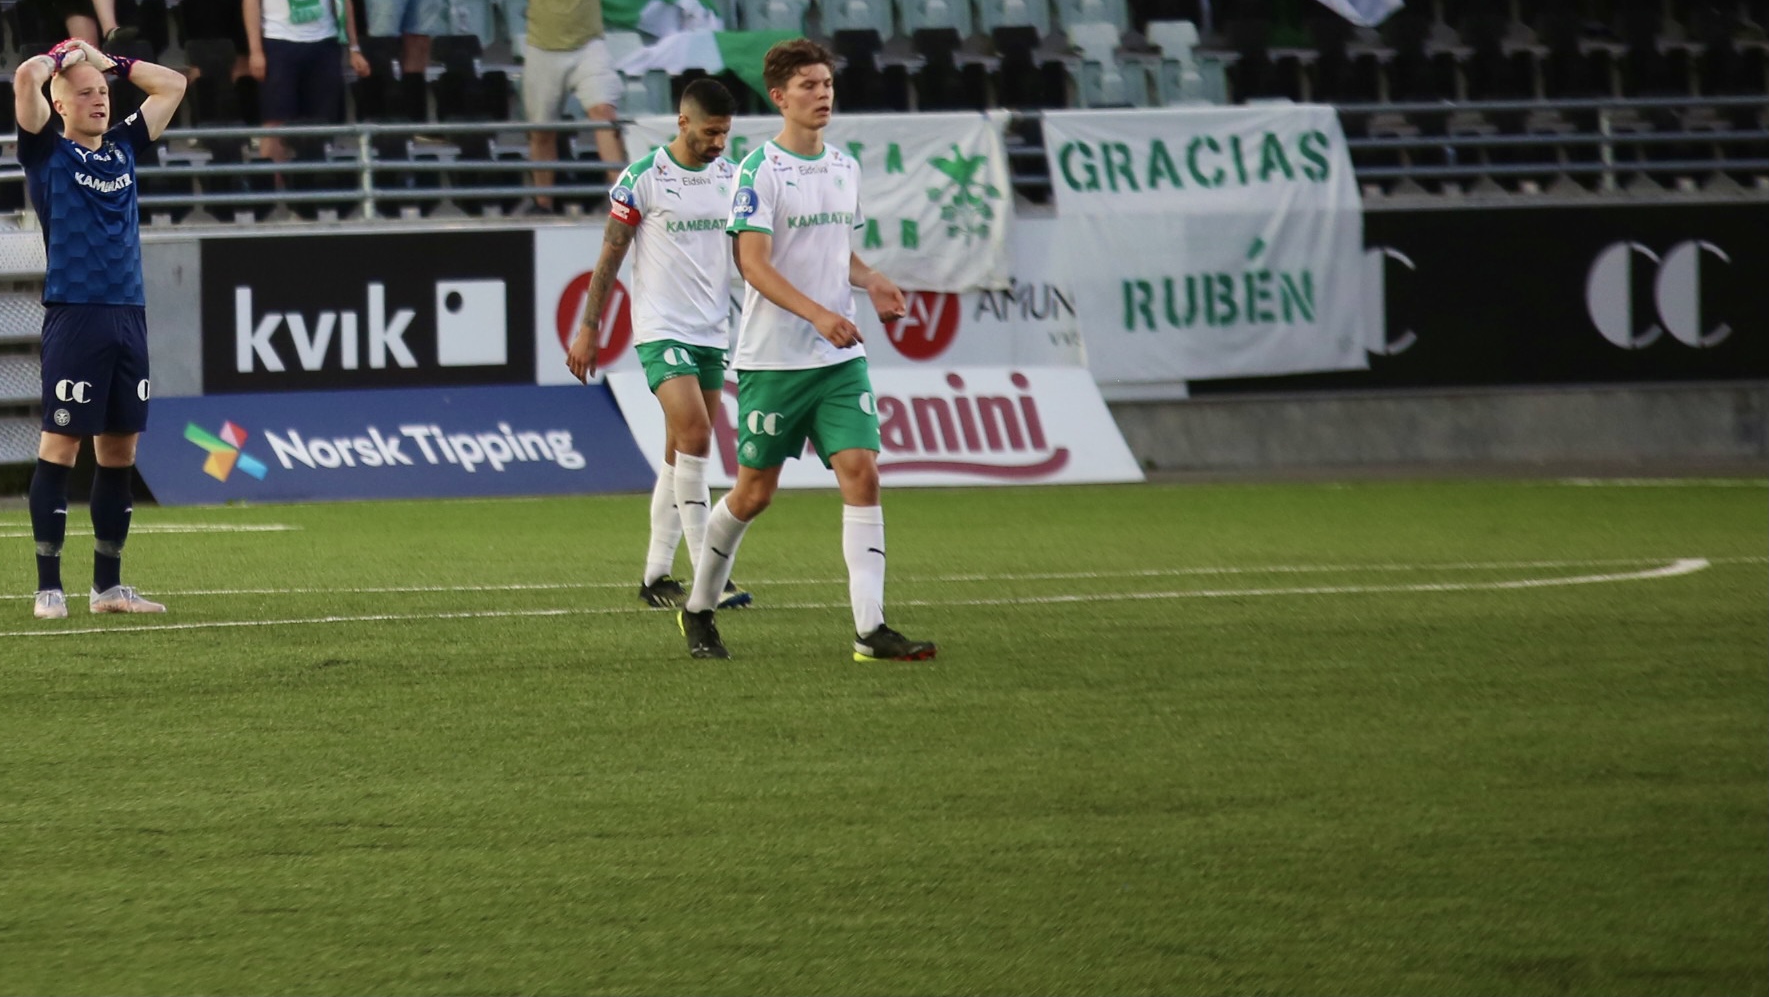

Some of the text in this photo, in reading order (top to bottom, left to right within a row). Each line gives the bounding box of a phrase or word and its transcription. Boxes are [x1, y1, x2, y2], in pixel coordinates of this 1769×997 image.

[1058, 130, 1330, 193] GRACIAS
[1122, 236, 1316, 332] RUBÉN
[1586, 240, 1733, 350] CC
[235, 283, 419, 373] kvik
[55, 378, 93, 404] CC
[264, 423, 586, 472] Norsk Tipping
[747, 409, 785, 437] CC
